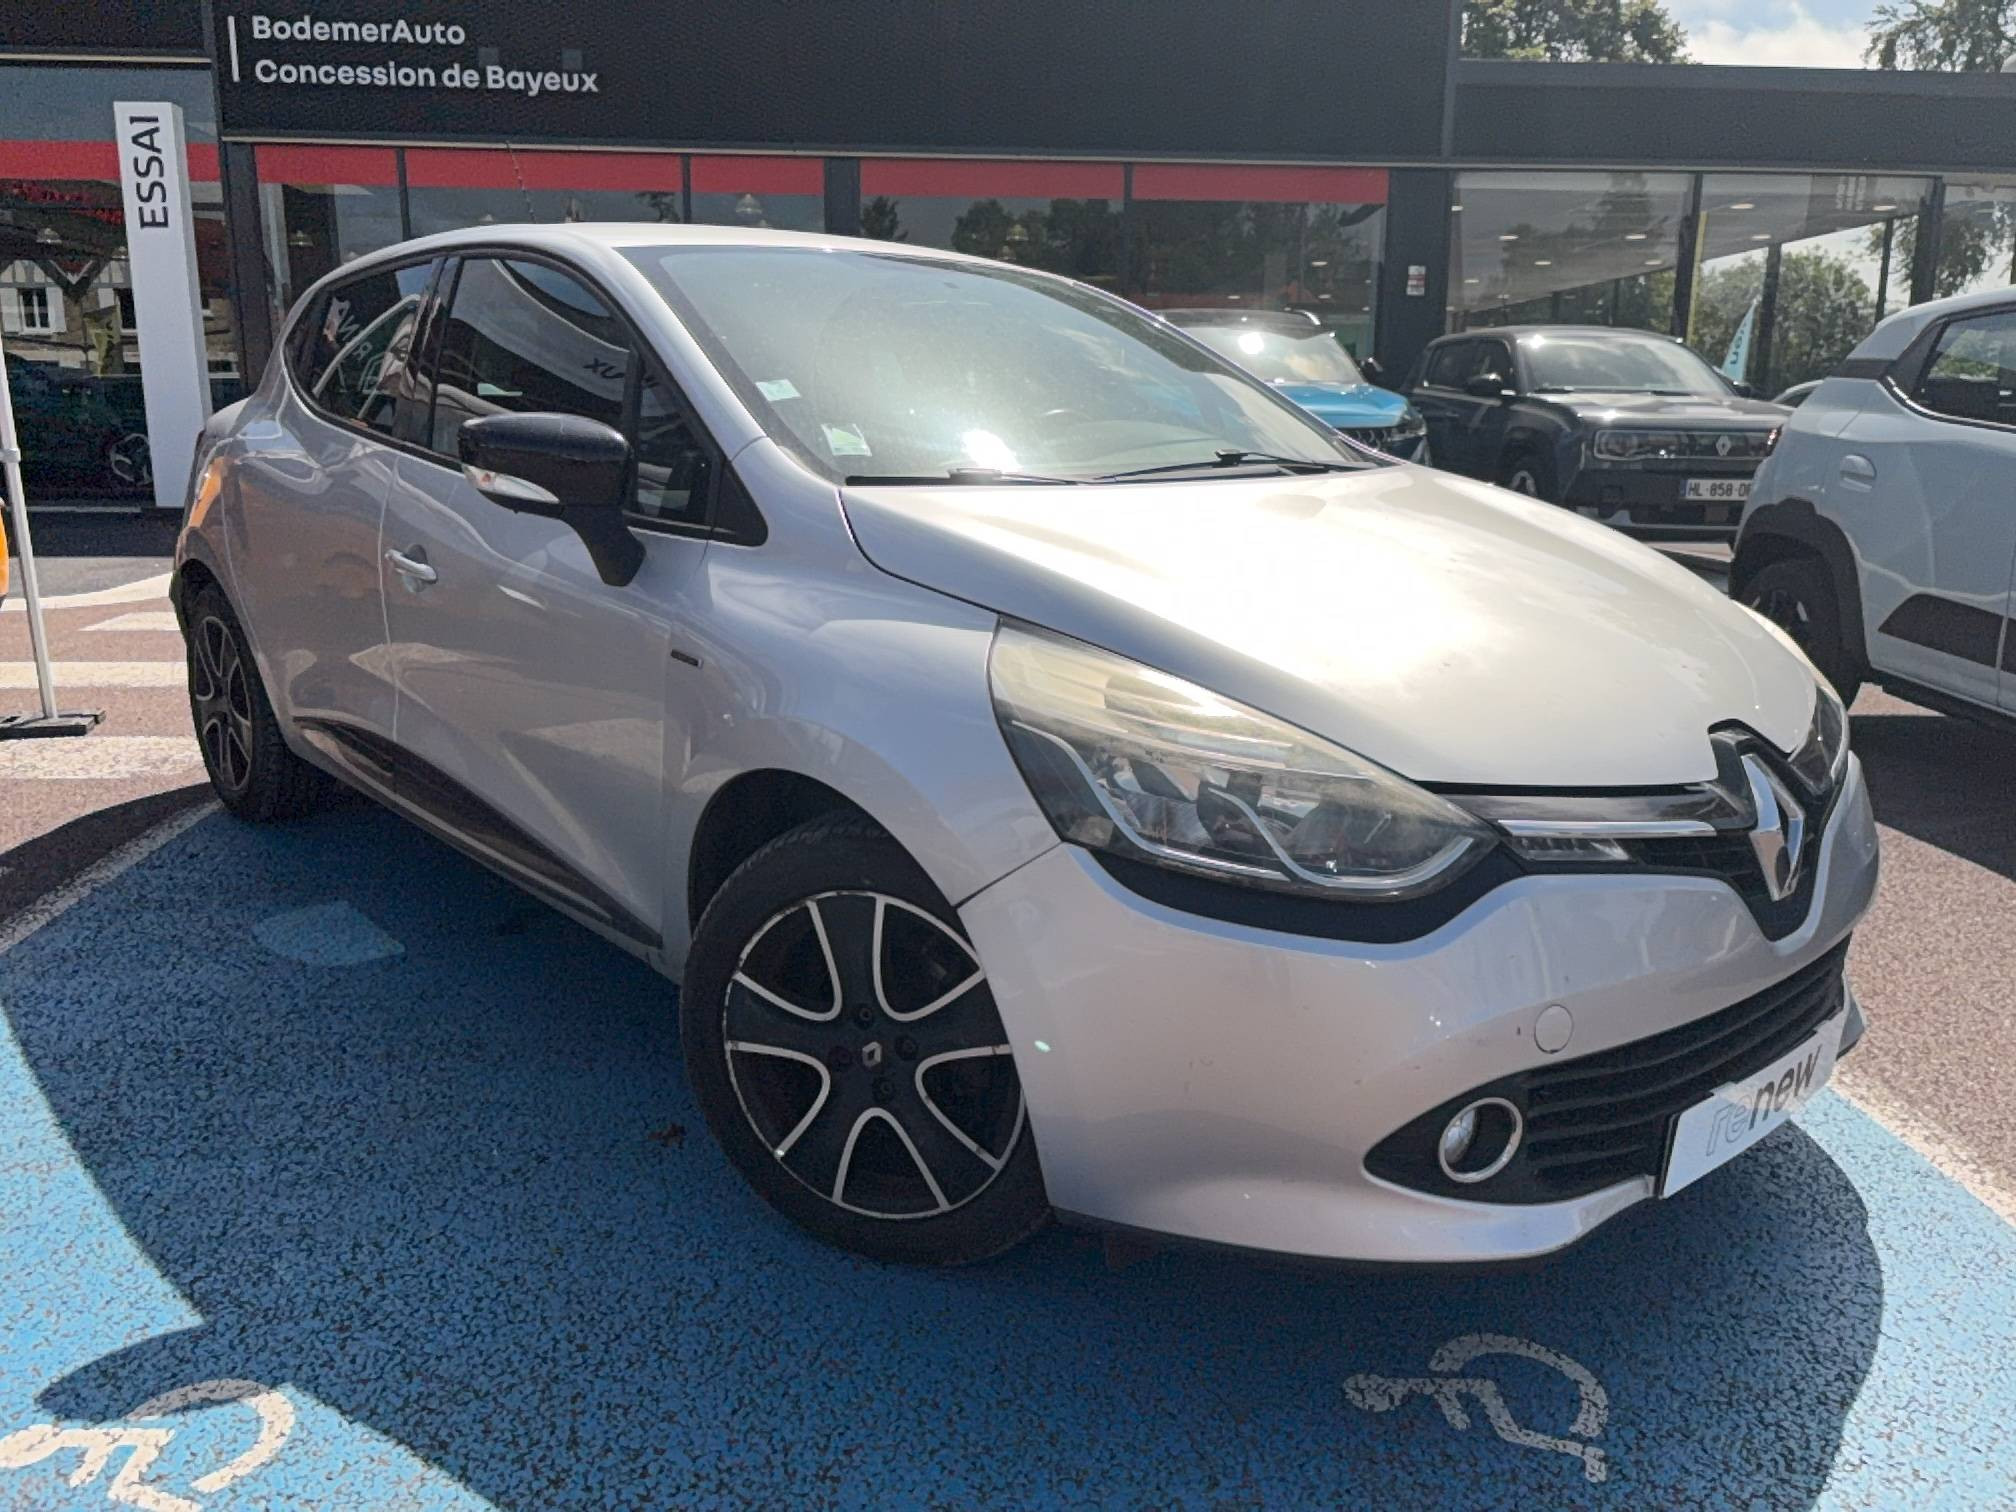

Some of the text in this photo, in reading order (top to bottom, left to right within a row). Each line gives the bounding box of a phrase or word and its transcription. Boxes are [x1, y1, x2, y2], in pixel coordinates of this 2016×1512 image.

[251, 15, 466, 45] BodemerAuto
[254, 59, 599, 97] Concession de Bayeux
[128, 115, 169, 229] ESSAI
[1706, 1044, 1822, 1156] renew
